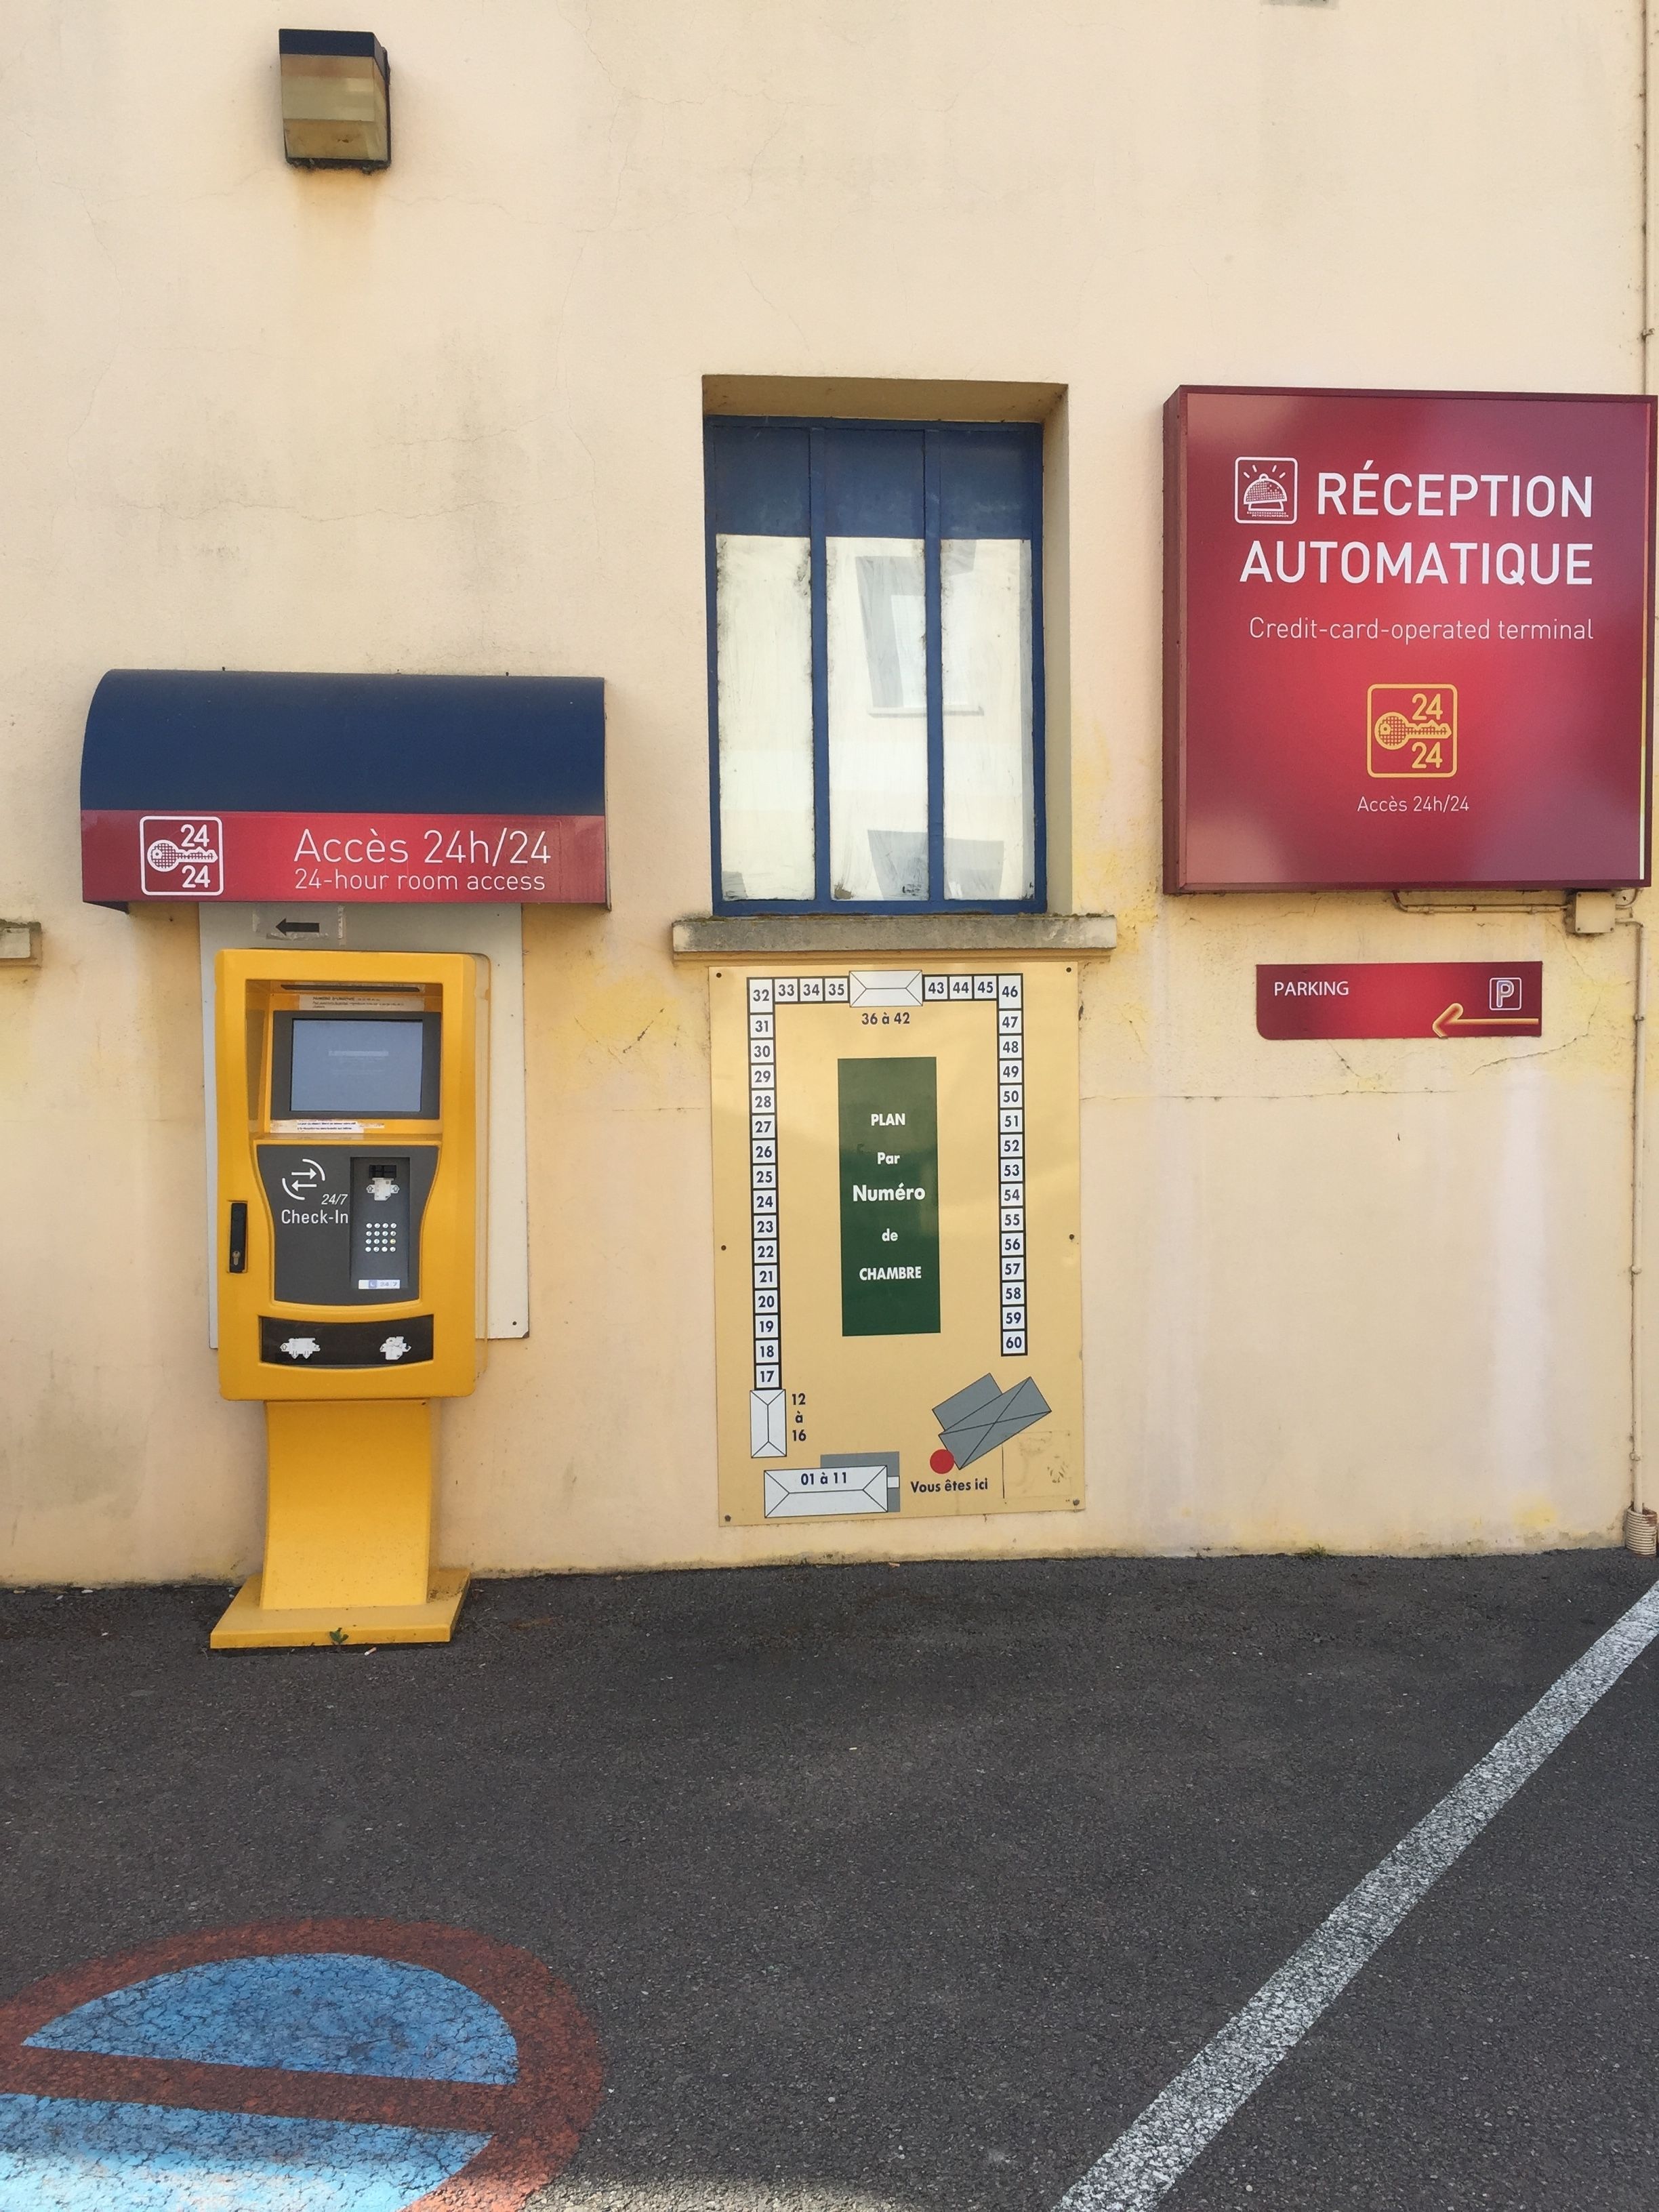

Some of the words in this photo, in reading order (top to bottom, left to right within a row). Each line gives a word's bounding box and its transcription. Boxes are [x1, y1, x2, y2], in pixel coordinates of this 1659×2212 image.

[1318, 460, 1592, 517] RÉCEPTION
[1240, 541, 1593, 586] AUTOMATIQUE
[1250, 617, 1489, 644] Credit-card-operated
[1498, 619, 1593, 639] terminal
[1412, 693, 1443, 720] 24
[1412, 742, 1442, 768] 24
[1357, 796, 1407, 811] Accès
[1414, 795, 1469, 813] 24h/24
[181, 824, 209, 847] 24
[294, 829, 408, 863] Accès
[424, 827, 551, 866] 24h/24
[182, 865, 210, 888] 24
[295, 868, 389, 889] 24-hour
[398, 876, 457, 889] room
[468, 876, 545, 890] access
[753, 989, 769, 1002] 32
[778, 984, 794, 996] 33
[803, 984, 819, 996] 34
[829, 984, 844, 996] 35
[928, 982, 944, 994] 43
[953, 982, 968, 994] 44
[978, 981, 993, 993] 45
[1002, 986, 1018, 998] 46
[1275, 981, 1349, 996] PARKING
[1496, 980, 1514, 1007] P
[862, 1013, 878, 1025] 36
[882, 1012, 889, 1024] à
[894, 1012, 909, 1024] 42
[1002, 1017, 1018, 1027] 47
[756, 1021, 768, 1032] 31
[754, 1046, 770, 1057] 30
[1003, 1041, 1018, 1053] 48
[754, 1071, 771, 1082] 29
[1003, 1066, 1019, 1078] 49
[755, 1096, 771, 1107] 28
[1004, 1090, 1019, 1103] 50
[872, 1113, 905, 1126] PLAN
[1005, 1115, 1018, 1127] 51
[755, 1121, 771, 1132] 27
[1004, 1140, 1019, 1151] 52
[756, 1146, 772, 1158] 26
[878, 1152, 900, 1164] Par
[1004, 1164, 1019, 1176] 53
[756, 1171, 772, 1183] 25
[853, 1183, 925, 1201] Numéro
[1004, 1189, 1019, 1201] 54
[321, 1194, 348, 1205] 24/7
[756, 1196, 773, 1208] 24
[282, 1210, 348, 1223] Check-In
[1005, 1214, 1019, 1226] 55
[757, 1221, 773, 1233] 23
[882, 1229, 898, 1241] de
[1005, 1238, 1020, 1250] 56
[758, 1246, 773, 1258] 22
[859, 1267, 921, 1280] CHAMBRE
[1005, 1263, 1020, 1275] 57
[760, 1271, 772, 1282] 21
[1006, 1288, 1021, 1299] 58
[758, 1296, 774, 1307] 20
[1006, 1312, 1021, 1324] 59
[760, 1321, 773, 1332] 19
[1006, 1336, 1021, 1349] 60
[760, 1345, 774, 1357] 18
[760, 1370, 774, 1382] 17
[792, 1393, 805, 1405] 12
[796, 1411, 802, 1423] à
[792, 1429, 806, 1441] 16
[801, 1473, 814, 1485] 01
[821, 1472, 827, 1484] à
[834, 1472, 846, 1483] 11
[911, 1481, 941, 1493] Vous
[945, 1479, 971, 1491] êtes
[975, 1478, 987, 1490] ici
